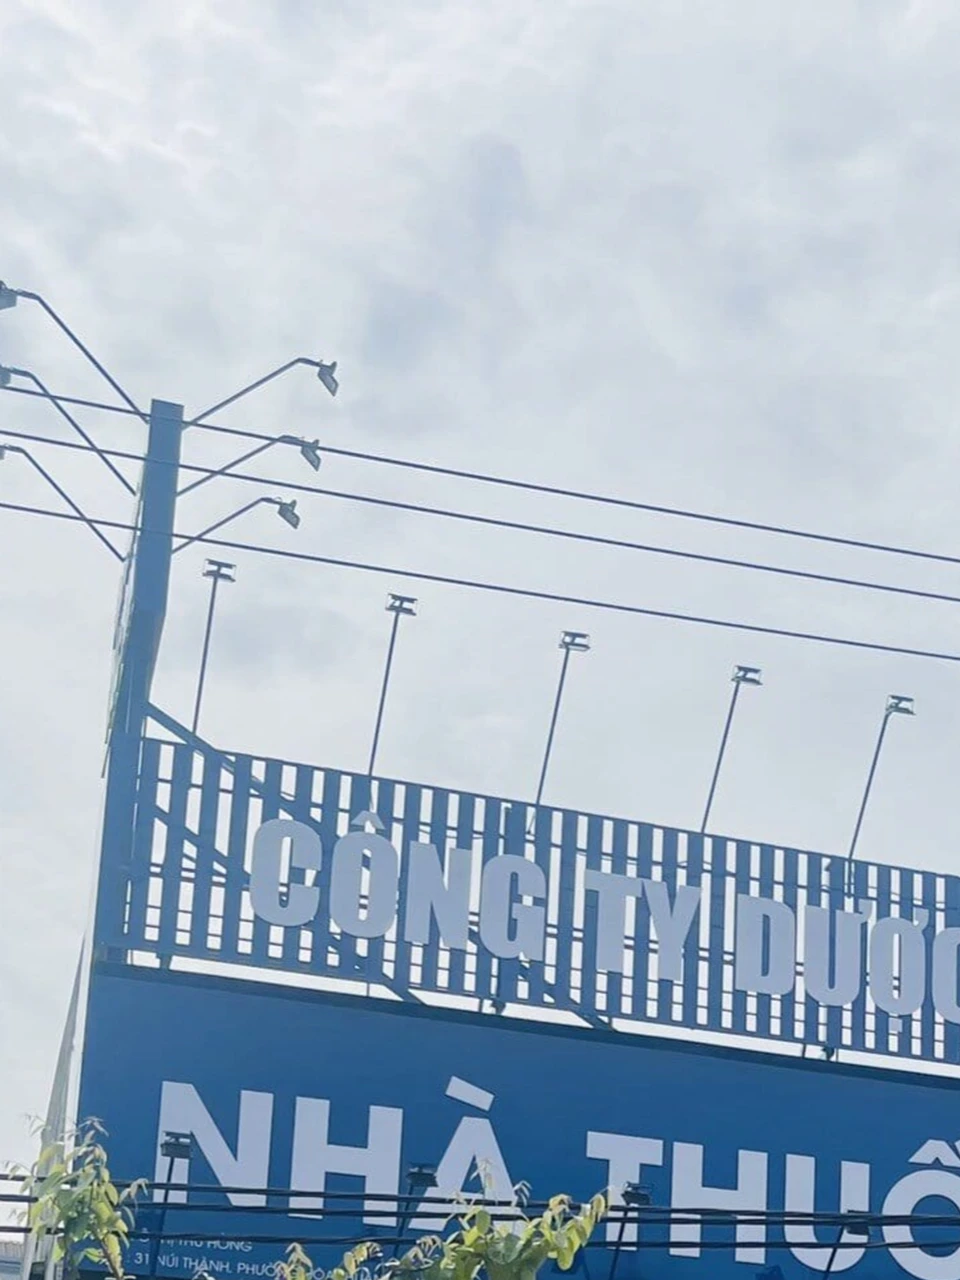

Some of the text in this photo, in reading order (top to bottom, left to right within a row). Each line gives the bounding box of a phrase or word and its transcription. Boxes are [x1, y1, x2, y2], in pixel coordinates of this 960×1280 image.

[250, 811, 546, 962] CÔNG
[585, 870, 701, 982] TY
[154, 1076, 528, 1235] NHÀ
